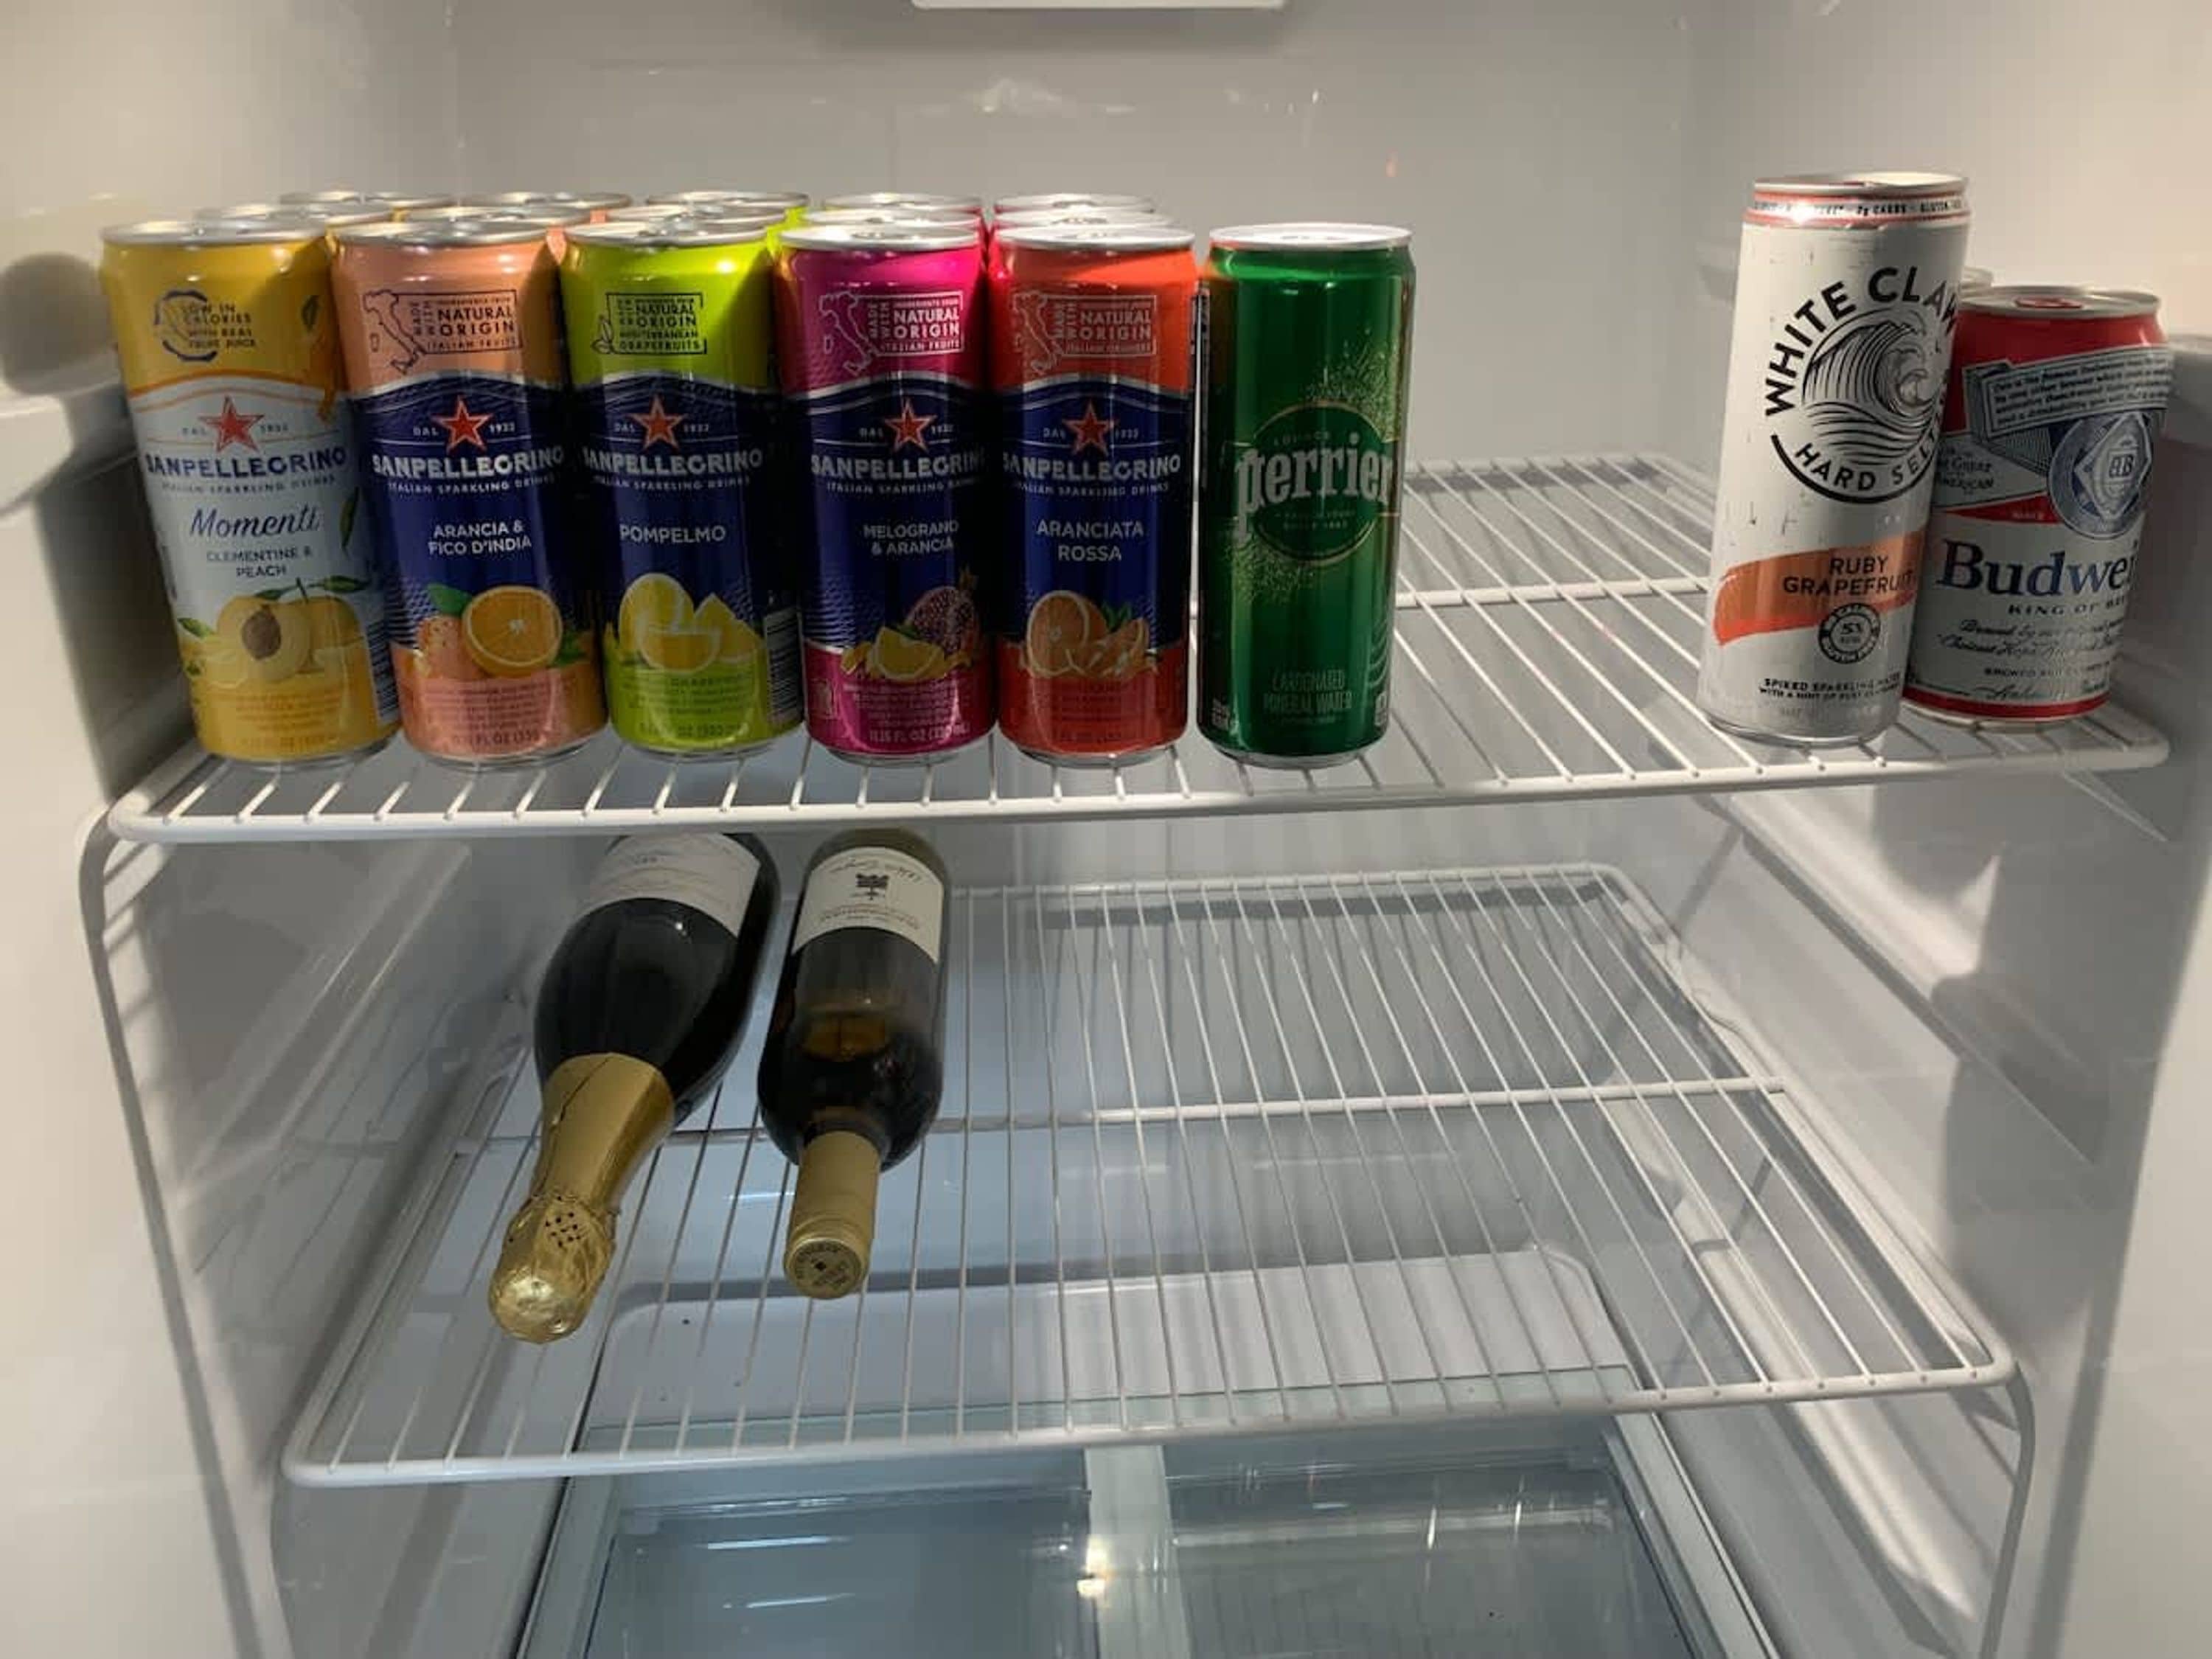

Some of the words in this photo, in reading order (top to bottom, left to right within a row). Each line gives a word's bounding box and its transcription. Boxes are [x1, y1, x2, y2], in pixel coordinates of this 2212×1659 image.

[438, 305, 512, 321] NATURAL
[636, 303, 695, 315] NATURAL
[894, 307, 959, 324] NATURAL
[1079, 310, 1151, 324] NATURAL
[440, 321, 514, 336] ORIGIN
[636, 315, 696, 327] ORIGIN
[894, 322, 959, 338] ORIGIN
[1078, 325, 1151, 341] ORIGIN
[1765, 281, 1857, 416] WHITE
[414, 427, 439, 436] DAL
[372, 445, 564, 479] SANPELLEGRINO
[1795, 442, 1877, 484] HARD
[434, 522, 509, 538] ARANCIA
[619, 524, 726, 543] POMPELMO
[863, 520, 959, 539] MELOGRANO
[1036, 519, 1144, 539] ARANCIATA
[428, 541, 467, 555] FICO
[472, 535, 532, 554] D'INDIA
[886, 536, 954, 555] ARANCIA
[1058, 545, 1122, 561] ROSSA
[206, 549, 297, 562] CLEMENTINE
[236, 565, 286, 577] PEACH
[1829, 554, 1889, 575] RUBY
[2007, 603, 2065, 616] KING
[2074, 604, 2100, 615] OF
[1764, 678, 1808, 690] SPIKED
